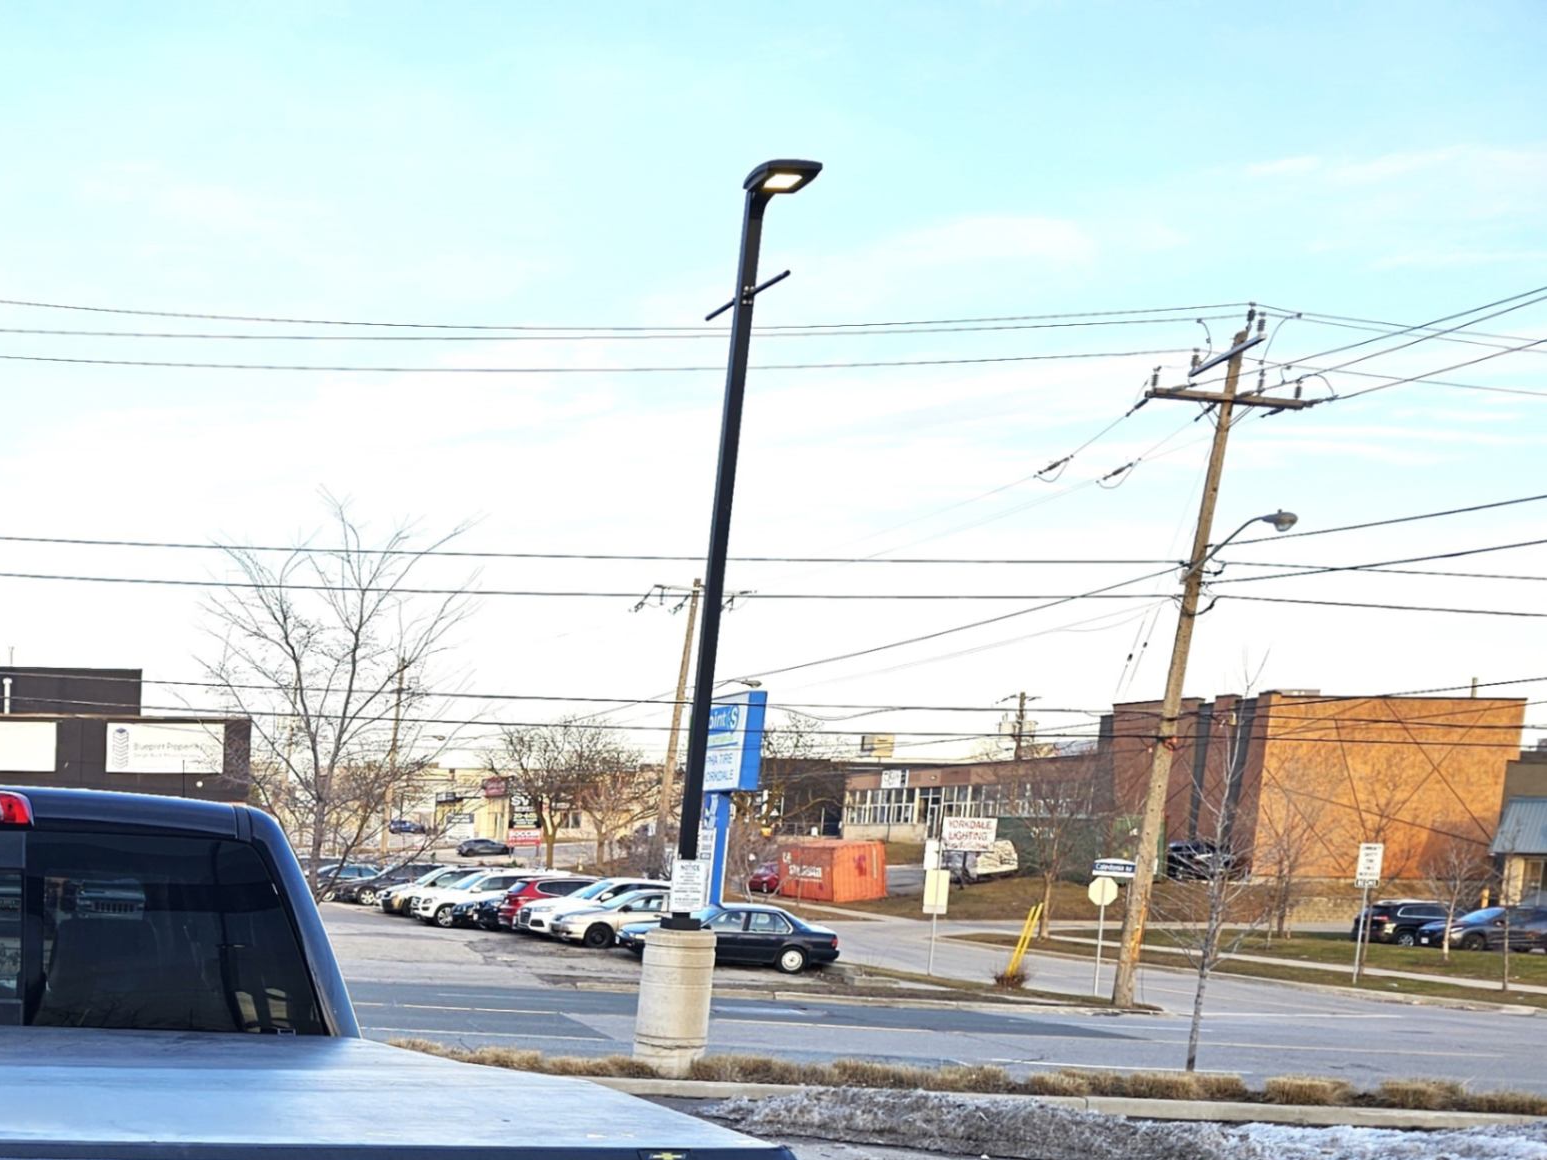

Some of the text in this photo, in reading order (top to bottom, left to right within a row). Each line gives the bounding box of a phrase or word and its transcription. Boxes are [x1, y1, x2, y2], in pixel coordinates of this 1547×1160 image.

[948, 820, 993, 830] YORKDALE
[948, 831, 989, 840] LIGHTING
[680, 864, 700, 872] NOTICE
